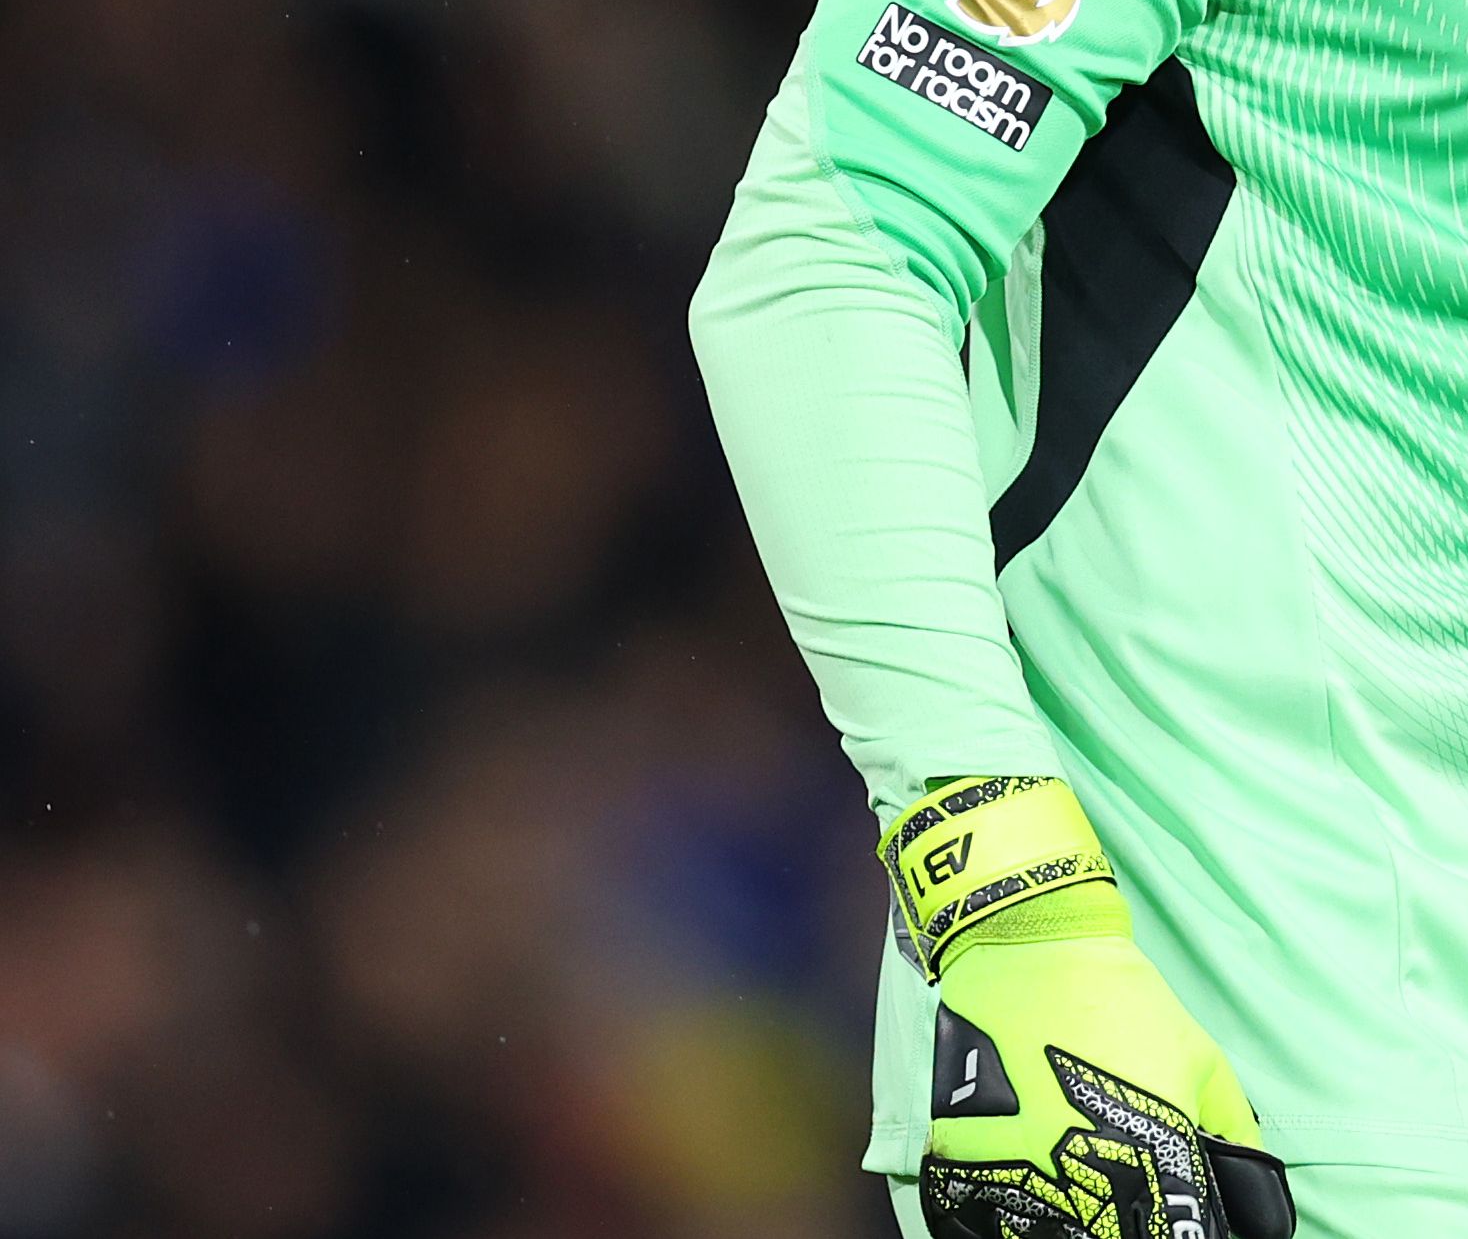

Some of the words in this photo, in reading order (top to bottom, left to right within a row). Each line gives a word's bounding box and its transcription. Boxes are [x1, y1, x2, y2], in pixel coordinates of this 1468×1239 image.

[857, 32, 916, 81] for
[910, 65, 1031, 151] racism
[873, 2, 930, 54] No
[928, 37, 1032, 114] room
